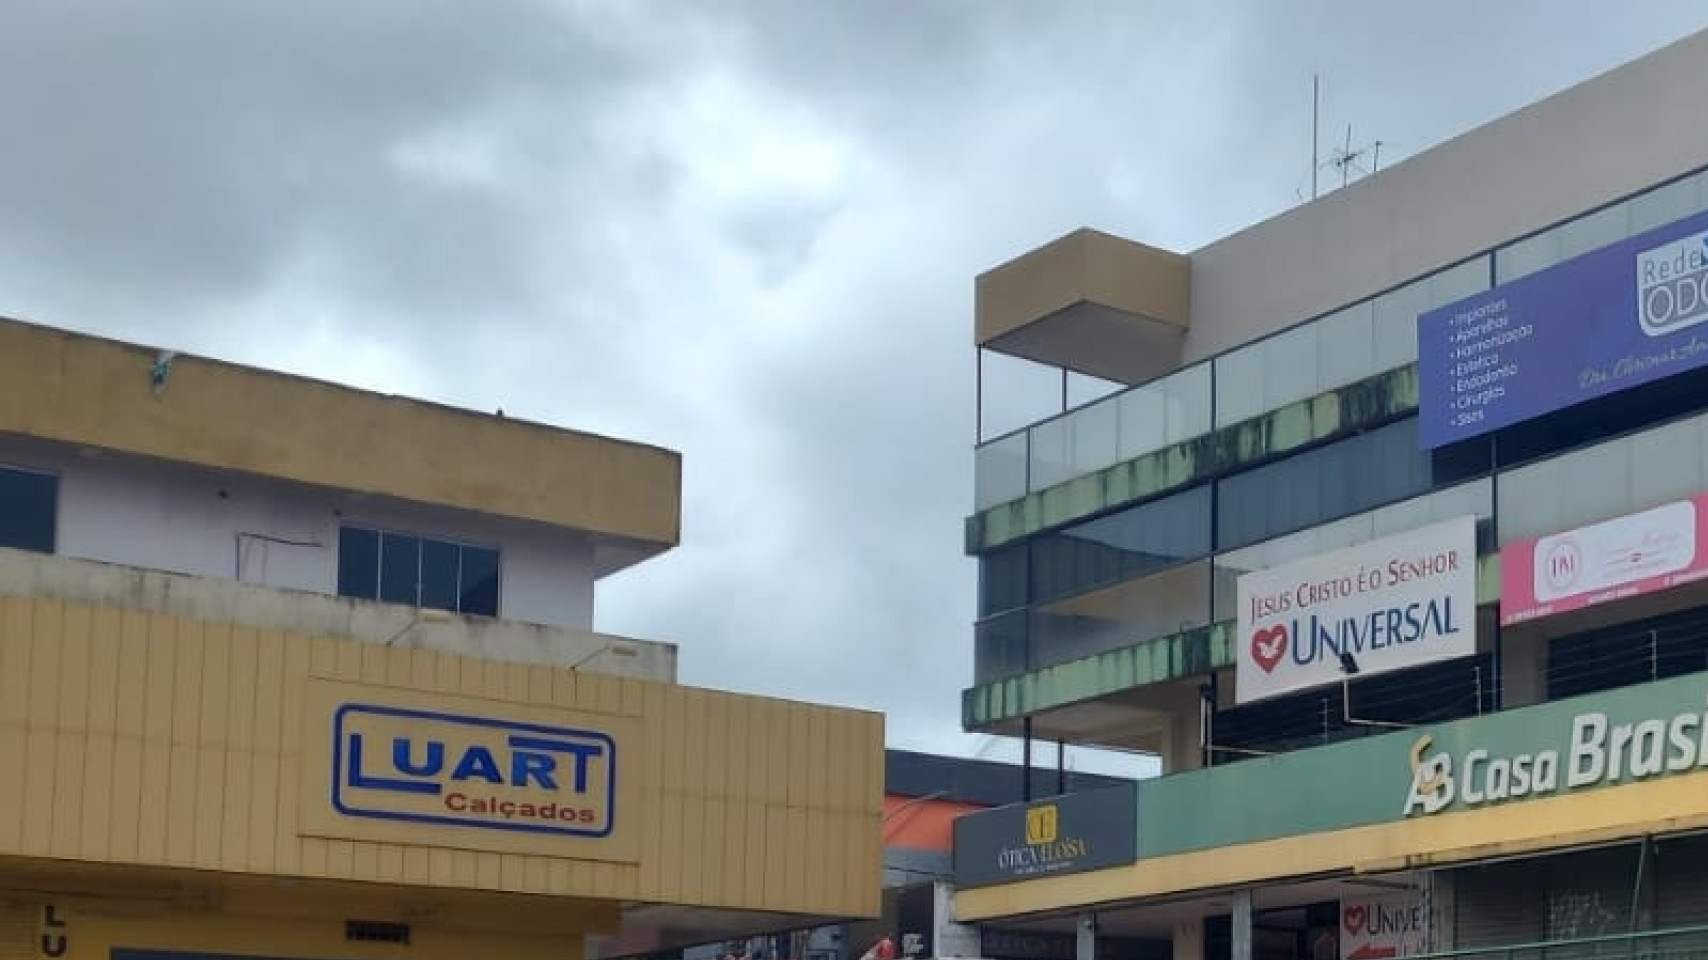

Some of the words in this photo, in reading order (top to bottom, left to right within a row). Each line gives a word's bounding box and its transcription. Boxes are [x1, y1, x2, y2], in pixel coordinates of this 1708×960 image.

[1644, 246, 1701, 282] Rede
[1251, 592, 1292, 626] JESUS
[1296, 575, 1351, 609] CRISTO
[1369, 570, 1382, 591] O
[1387, 550, 1460, 587] SENHOR
[1292, 594, 1461, 666] UNIVERSAL
[348, 733, 603, 795] LUART
[1461, 749, 1559, 803] Casa
[444, 792, 596, 824] Calçados
